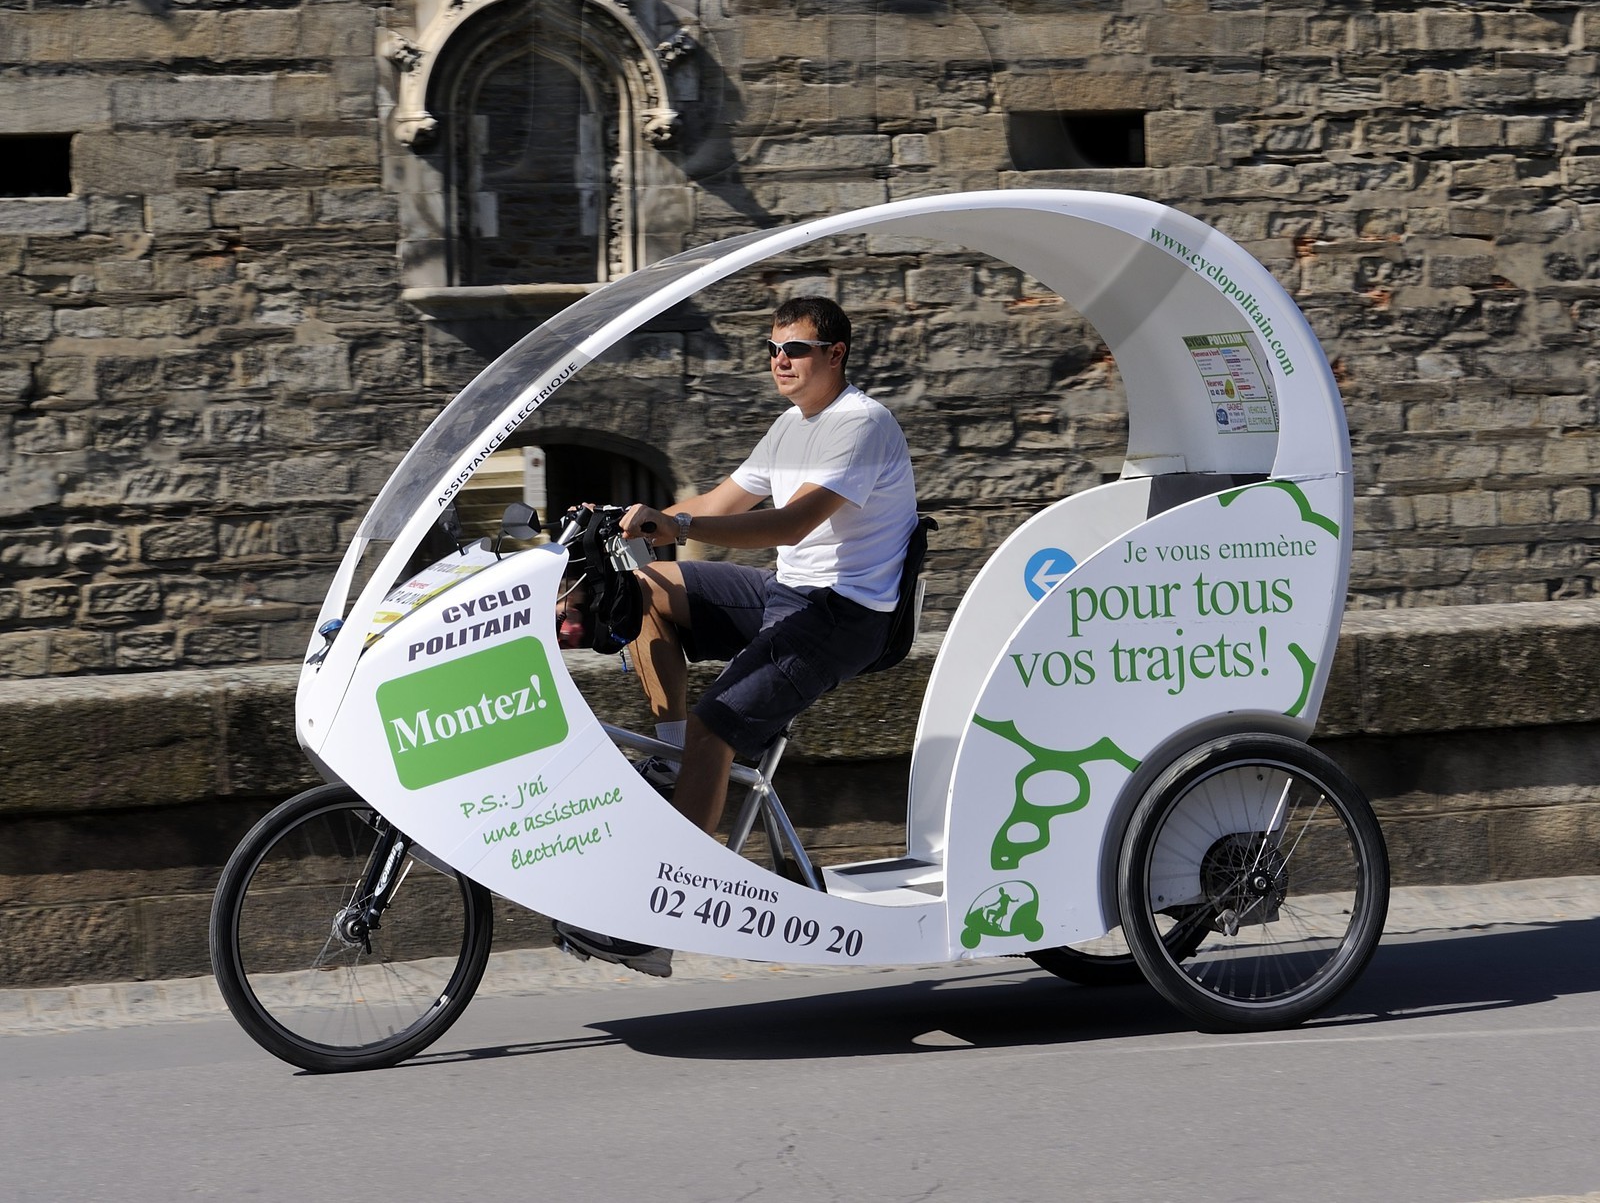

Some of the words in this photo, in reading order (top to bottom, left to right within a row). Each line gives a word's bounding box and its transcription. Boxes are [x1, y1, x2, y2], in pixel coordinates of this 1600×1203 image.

[1150, 227, 1295, 377] www.cyclopolitain.com
[1208, 334, 1243, 345] POLITAIN
[437, 432, 505, 507] ASSISTANCE
[505, 362, 578, 433] ELECTRIQUE
[1123, 540, 1148, 563] Je
[1155, 544, 1210, 562] vous
[1218, 535, 1317, 559] emmène
[442, 584, 531, 624] CYCLO
[1067, 579, 1181, 637] pour
[1193, 572, 1293, 617] tous
[409, 608, 531, 661] POLITAIN
[1010, 649, 1096, 688] vos
[1109, 626, 1269, 695] trajets!
[390, 675, 547, 753] Montez!
[483, 821, 520, 845] une
[524, 787, 623, 831] assistance
[511, 826, 602, 870] électrique
[657, 862, 779, 904] Réservations
[650, 886, 686, 918] 02
[694, 897, 731, 928] 40
[737, 907, 776, 937] 20
[784, 916, 820, 946] 09
[826, 926, 863, 957] 20
